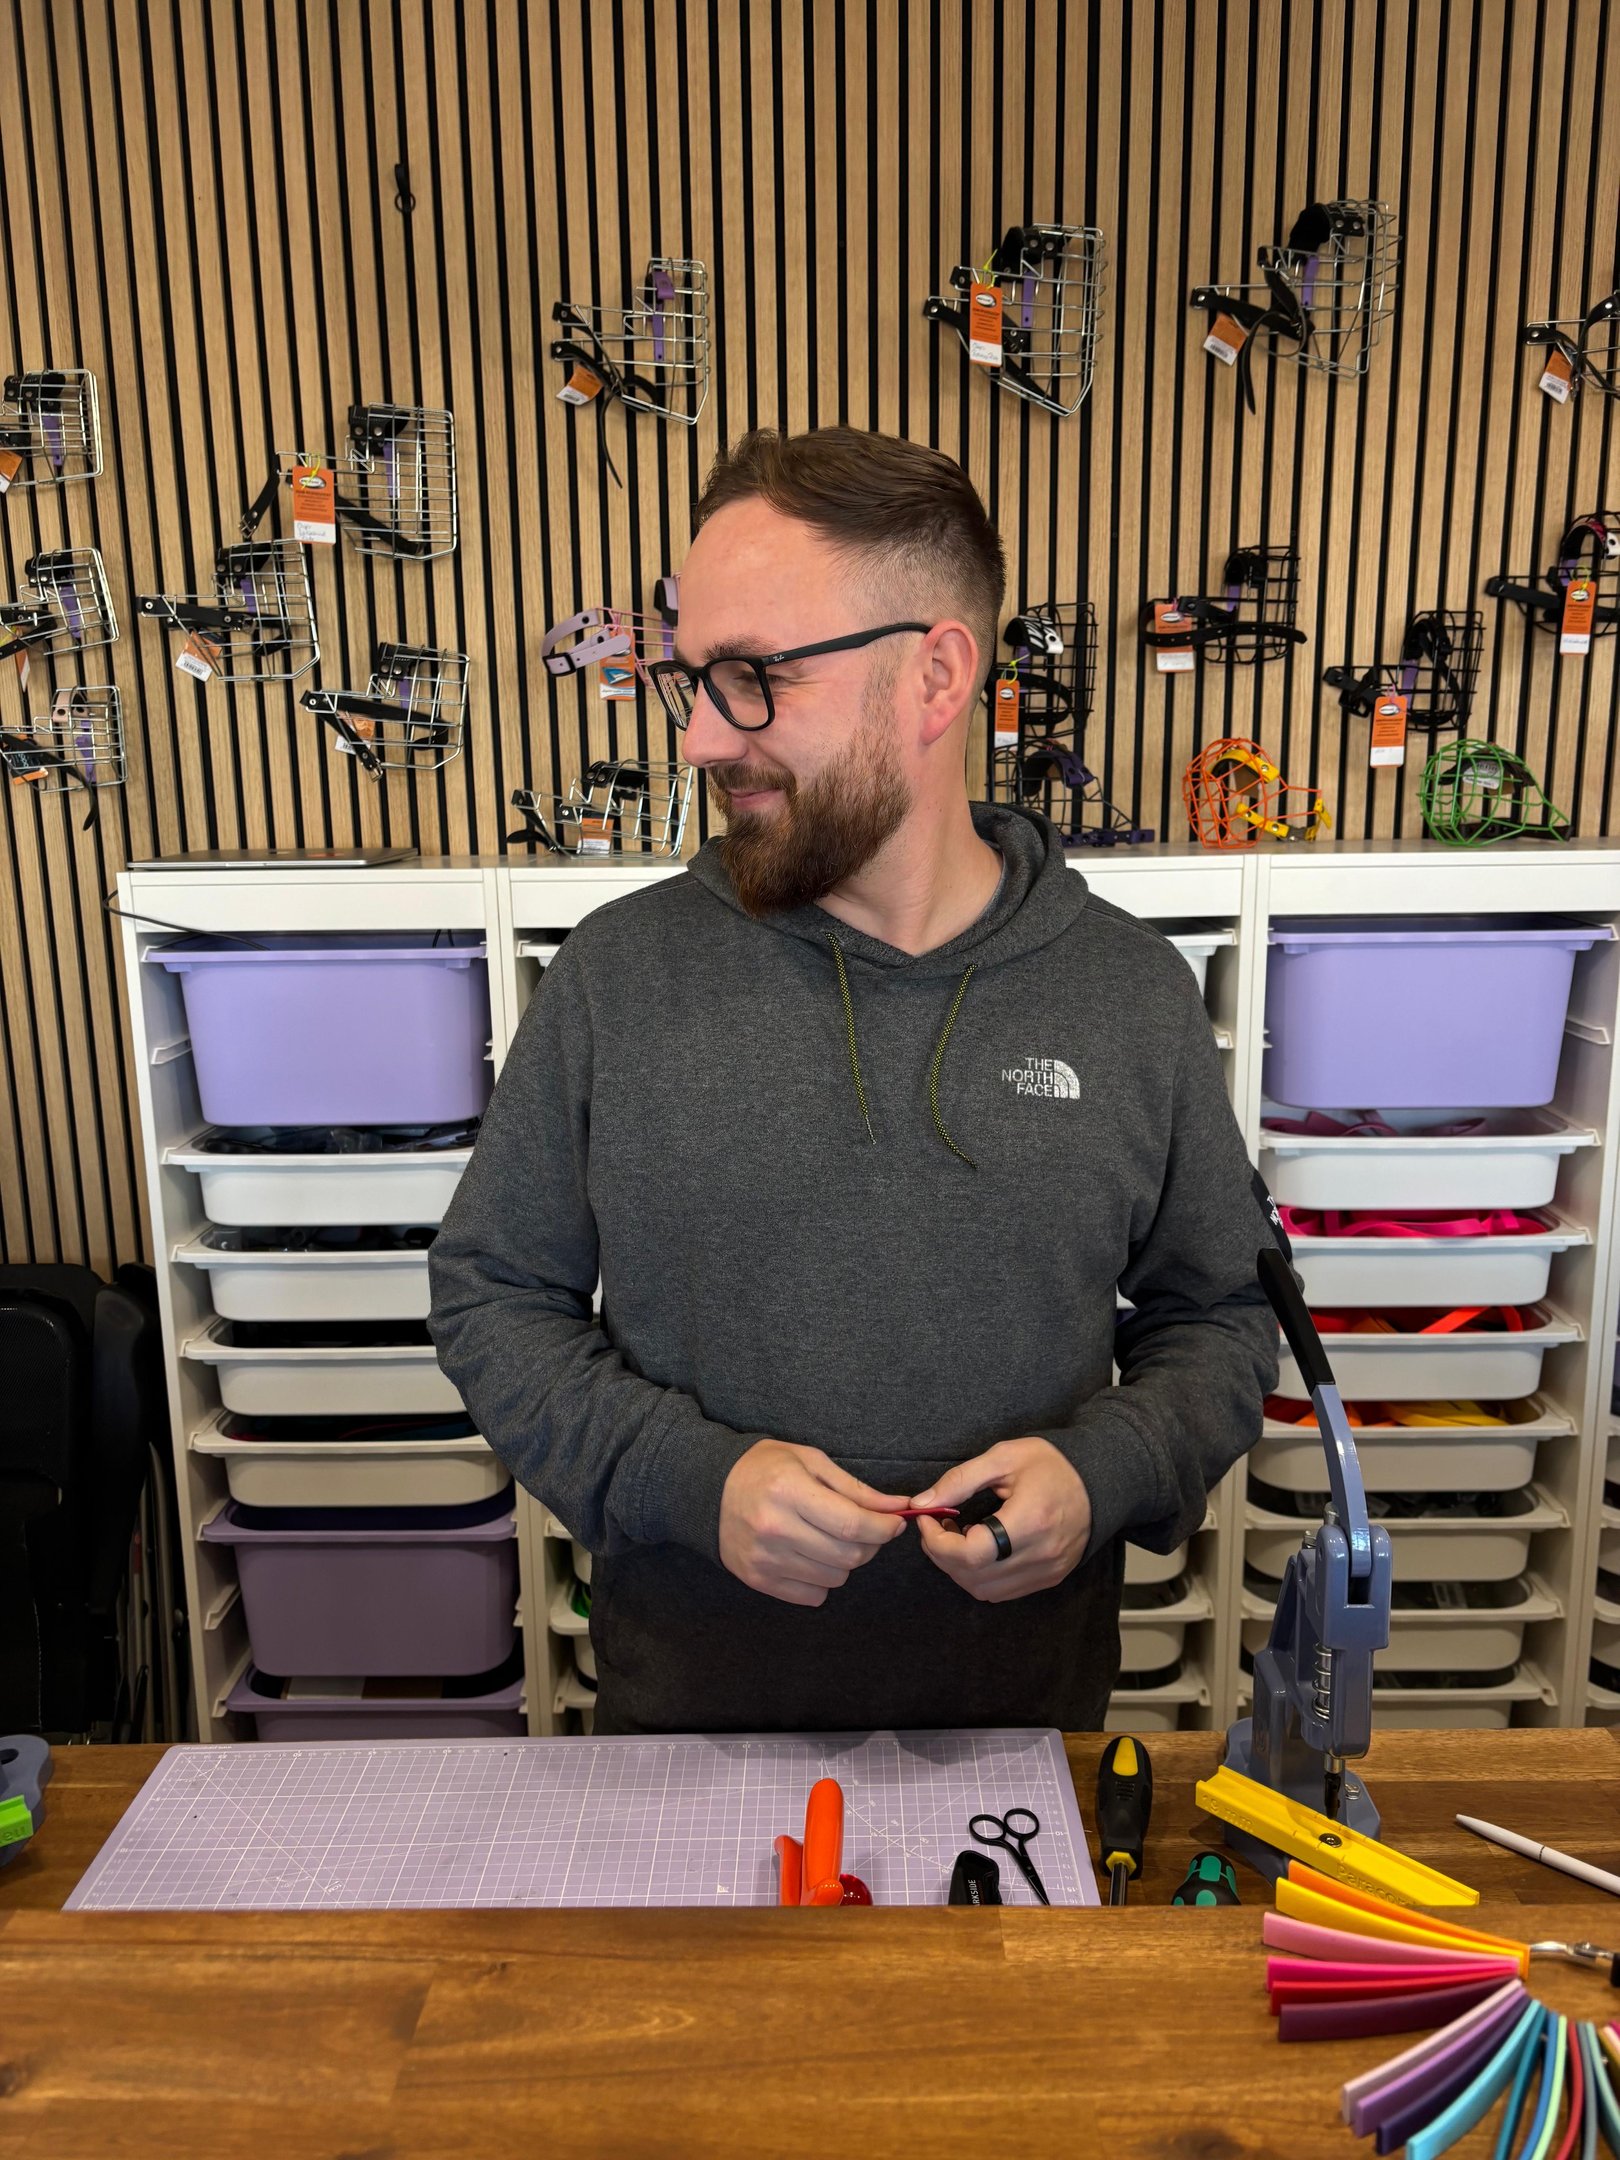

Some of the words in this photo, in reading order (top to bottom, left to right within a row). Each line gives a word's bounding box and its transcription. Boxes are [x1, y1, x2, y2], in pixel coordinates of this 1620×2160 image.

[1025, 1057, 1053, 1071] THE
[1001, 1069, 1053, 1085] NORTH
[1016, 1082, 1053, 1097] FACE
[967, 1879, 980, 1906] RKSIDE
[1337, 1862, 1416, 1907] Paraco
